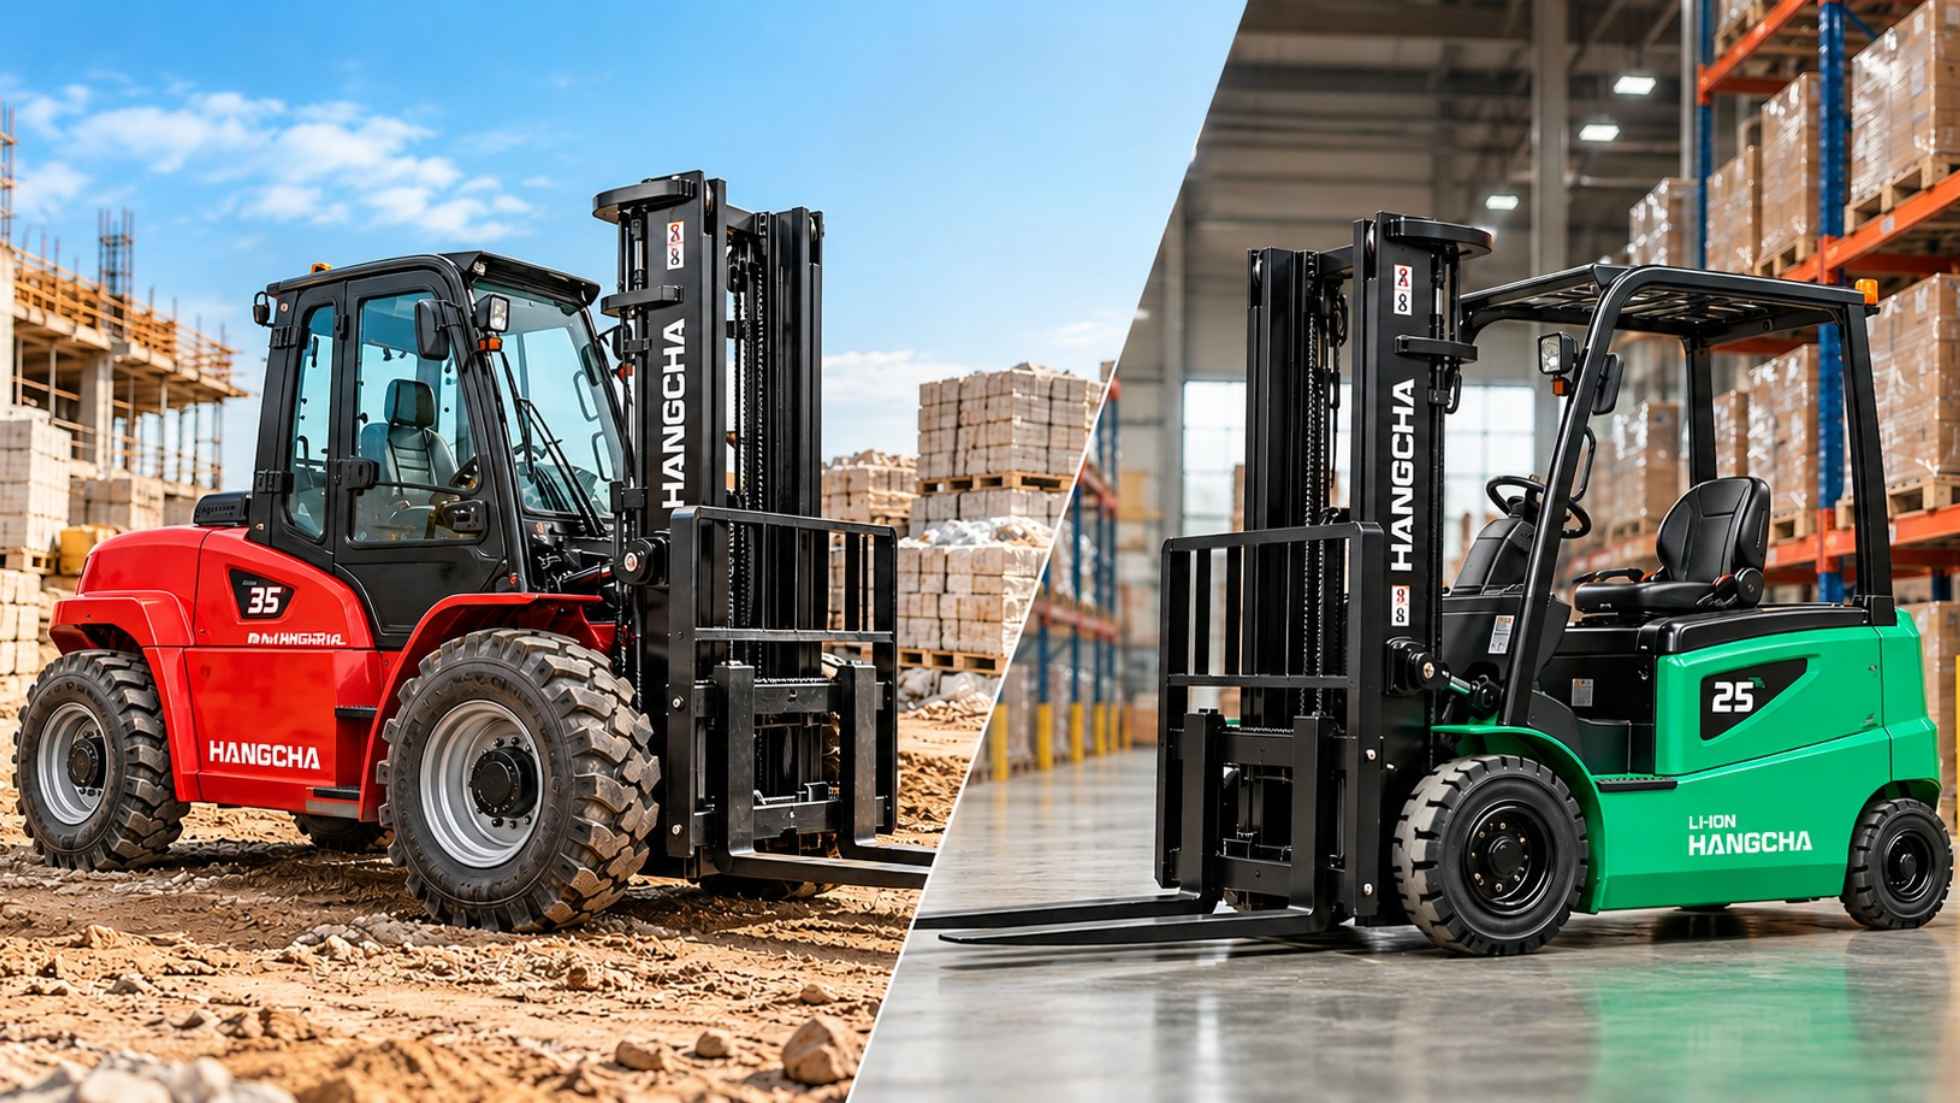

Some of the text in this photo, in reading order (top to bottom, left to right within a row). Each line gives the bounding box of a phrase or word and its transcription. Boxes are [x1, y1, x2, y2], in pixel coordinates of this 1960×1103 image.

[662, 318, 685, 509] HANGCHA
[1391, 379, 1414, 570] HANGCHA
[248, 587, 281, 613] 35
[1712, 682, 1753, 712] 25
[210, 740, 320, 769] HANGCHA
[1689, 814, 1736, 830] LI-ION
[1689, 831, 1812, 856] HANGCHA
